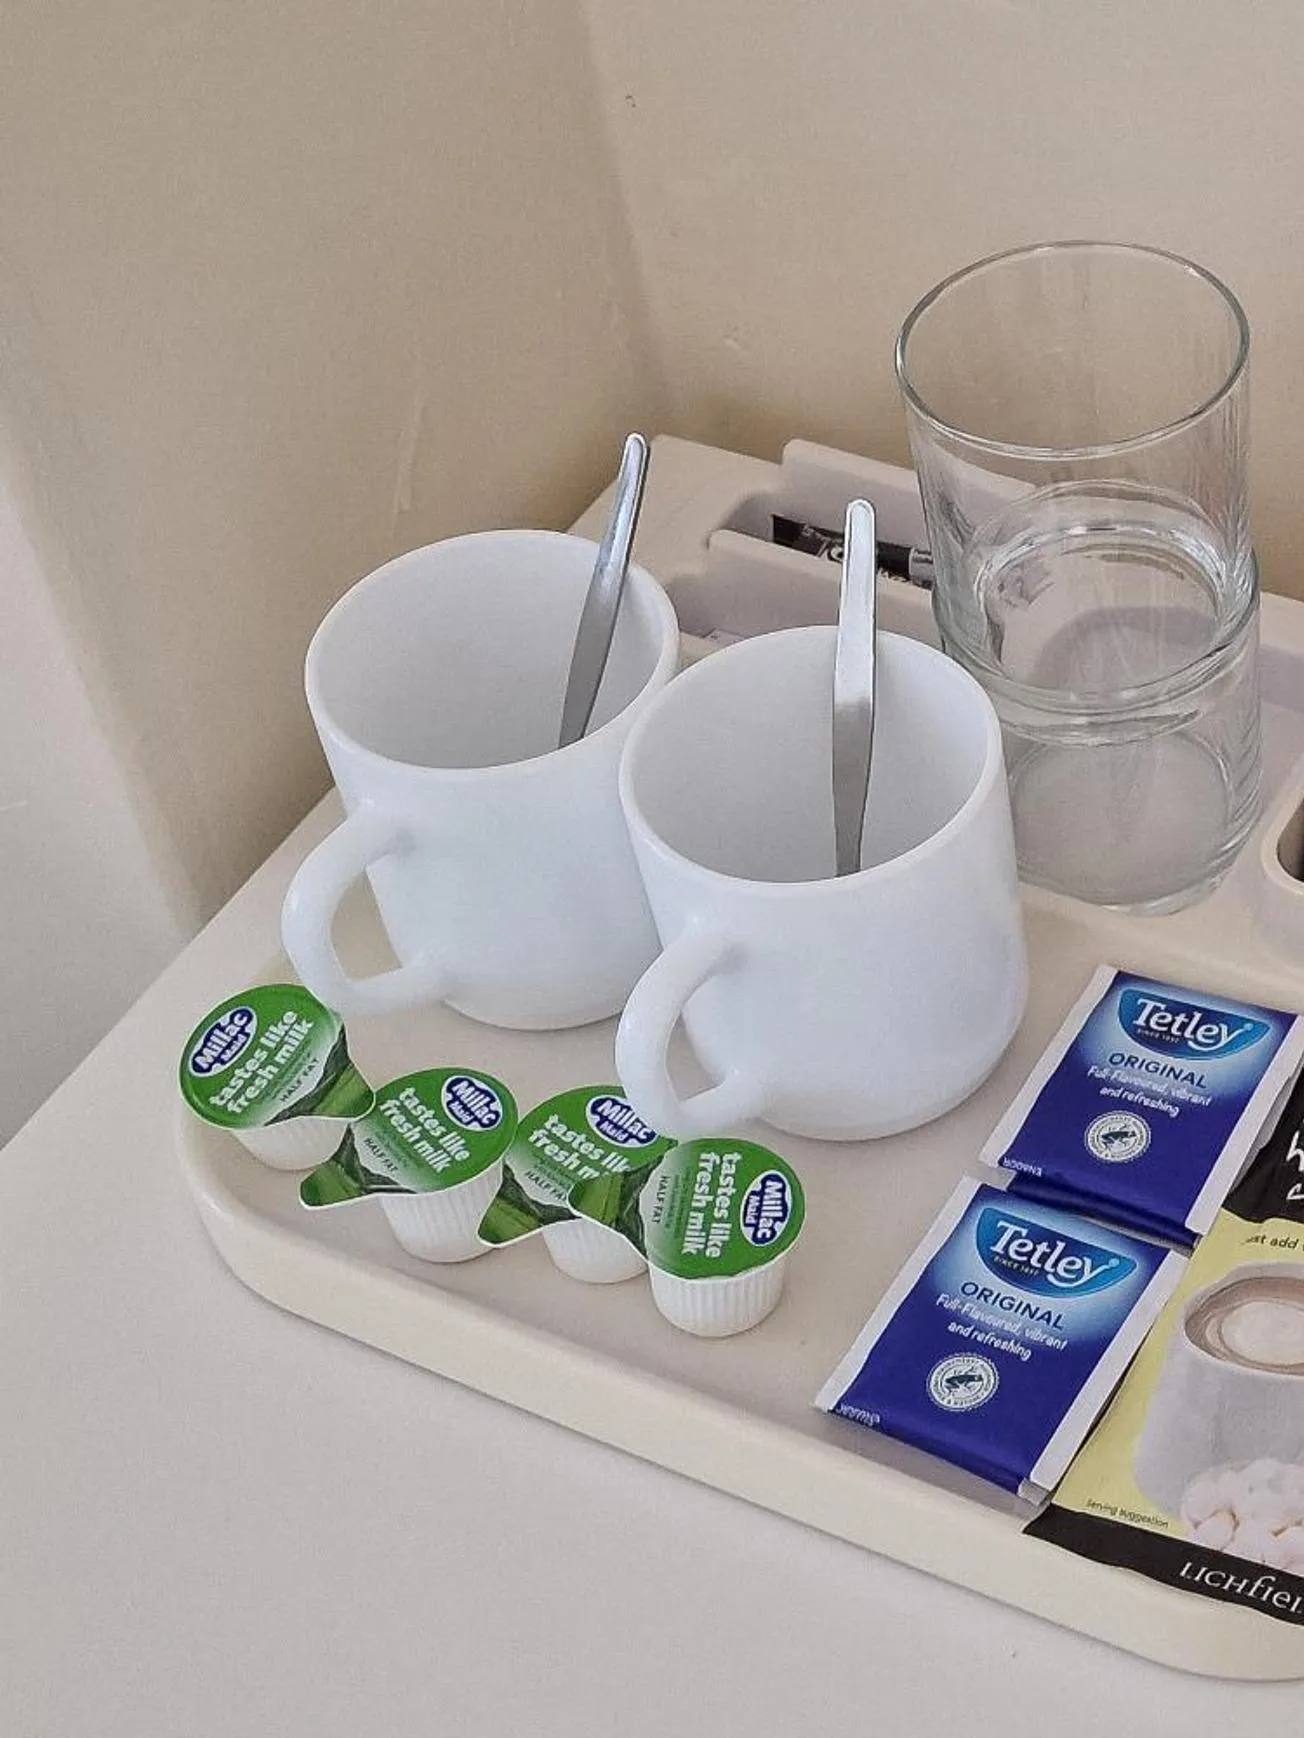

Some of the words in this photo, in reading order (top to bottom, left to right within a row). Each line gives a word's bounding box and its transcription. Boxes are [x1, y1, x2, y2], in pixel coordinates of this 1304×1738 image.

[194, 1012, 249, 1069] Millac
[221, 1033, 248, 1062] Maid
[1132, 998, 1254, 1052] Tetley
[210, 1049, 269, 1107] tastes
[260, 1010, 299, 1049] like
[226, 1064, 279, 1114] fresh
[274, 1020, 315, 1065] milk
[1108, 1052, 1207, 1089] ORIGINAL
[399, 1086, 447, 1137] tastes
[438, 1130, 471, 1162] like
[451, 1079, 497, 1125] Millac
[596, 1099, 649, 1140] Millac
[1099, 1086, 1123, 1099] and
[1122, 1090, 1180, 1119] refreshing
[379, 1099, 423, 1143] fresh
[413, 1139, 452, 1174] milk
[528, 1128, 581, 1170] fresh
[544, 1113, 605, 1160] tastes
[548, 1188, 567, 1201] FA
[691, 1151, 721, 1208] fresh
[713, 1151, 742, 1220] tastes
[756, 1180, 784, 1239] Millac
[681, 1211, 707, 1255] milk
[705, 1222, 733, 1258] like
[990, 1219, 1120, 1288] Tetley
[1269, 1236, 1299, 1250] add
[960, 1281, 1065, 1331] ORIGINAL
[948, 1321, 975, 1338] and
[971, 1329, 1032, 1363] refreshing
[1025, 1327, 1068, 1350] vibrant
